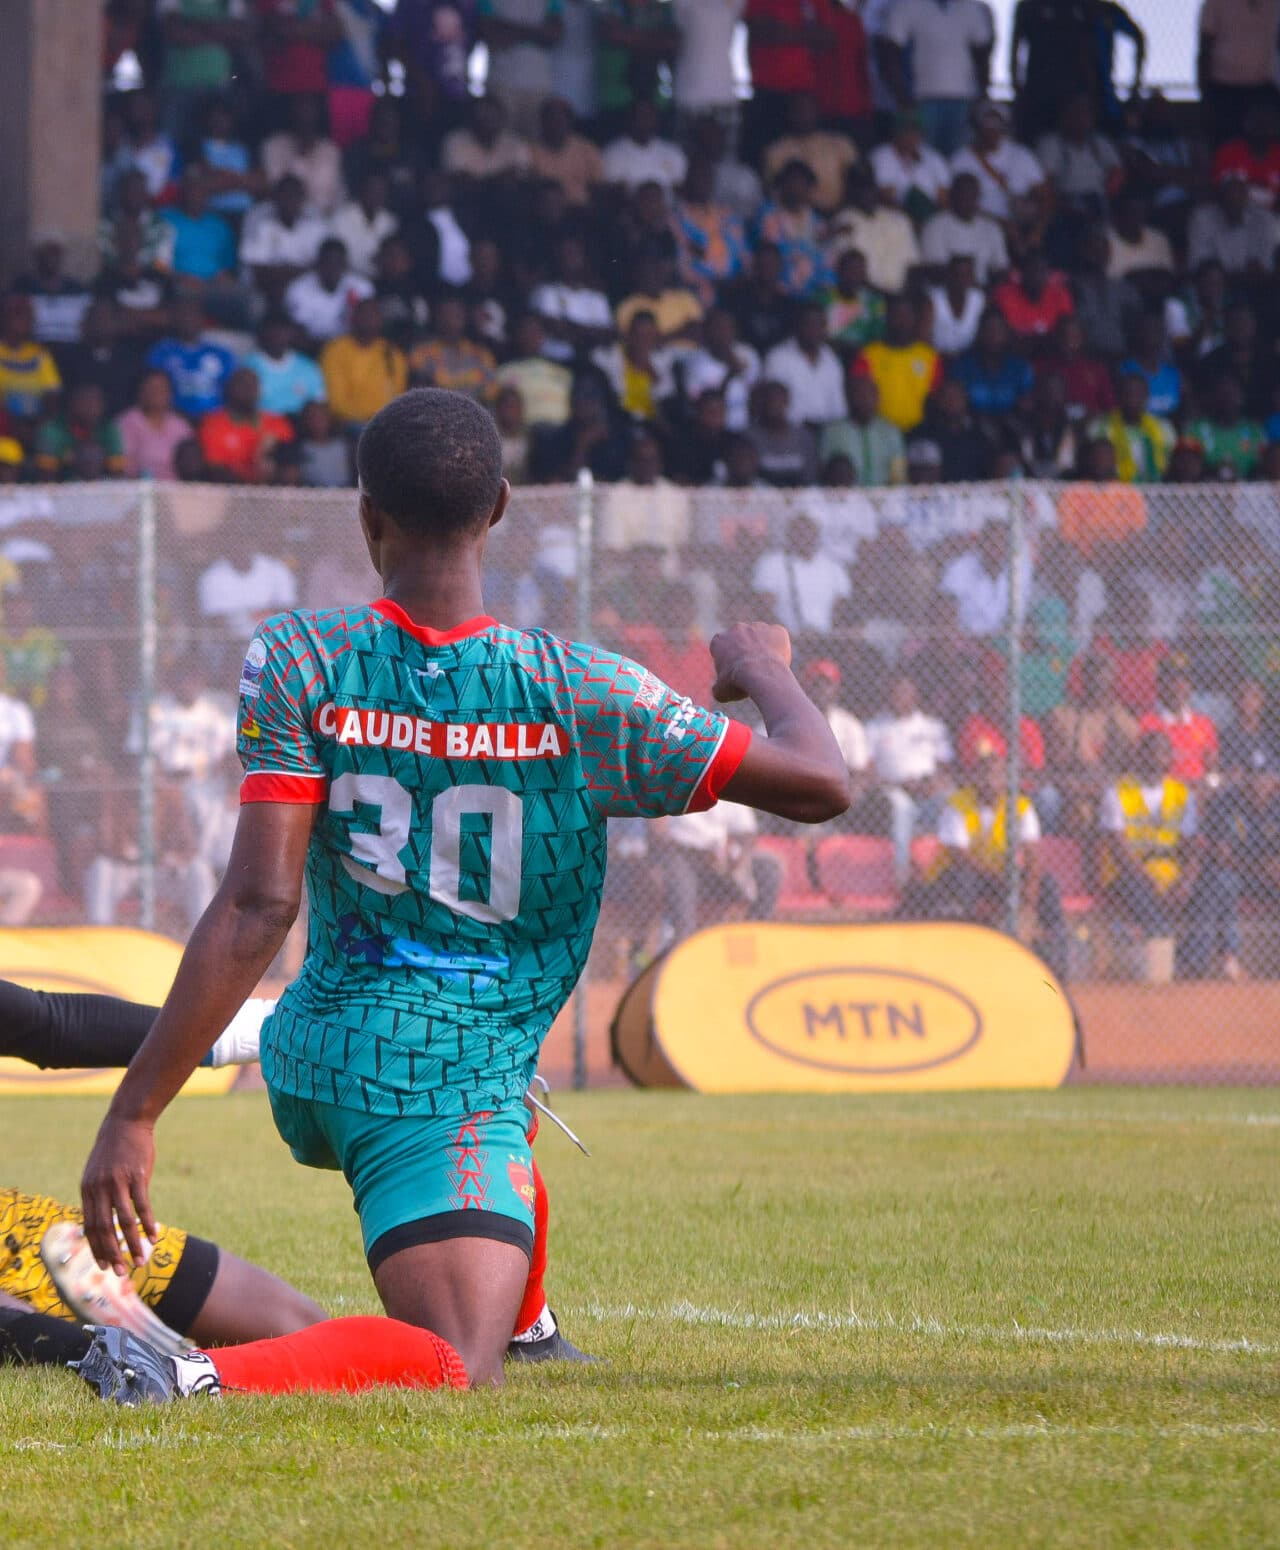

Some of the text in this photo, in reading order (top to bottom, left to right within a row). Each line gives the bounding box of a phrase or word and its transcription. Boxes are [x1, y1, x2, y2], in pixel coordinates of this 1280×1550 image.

[319, 701, 561, 757] CAUDE BALLA
[329, 773, 523, 925] 30
[803, 1002, 926, 1039] MTN
